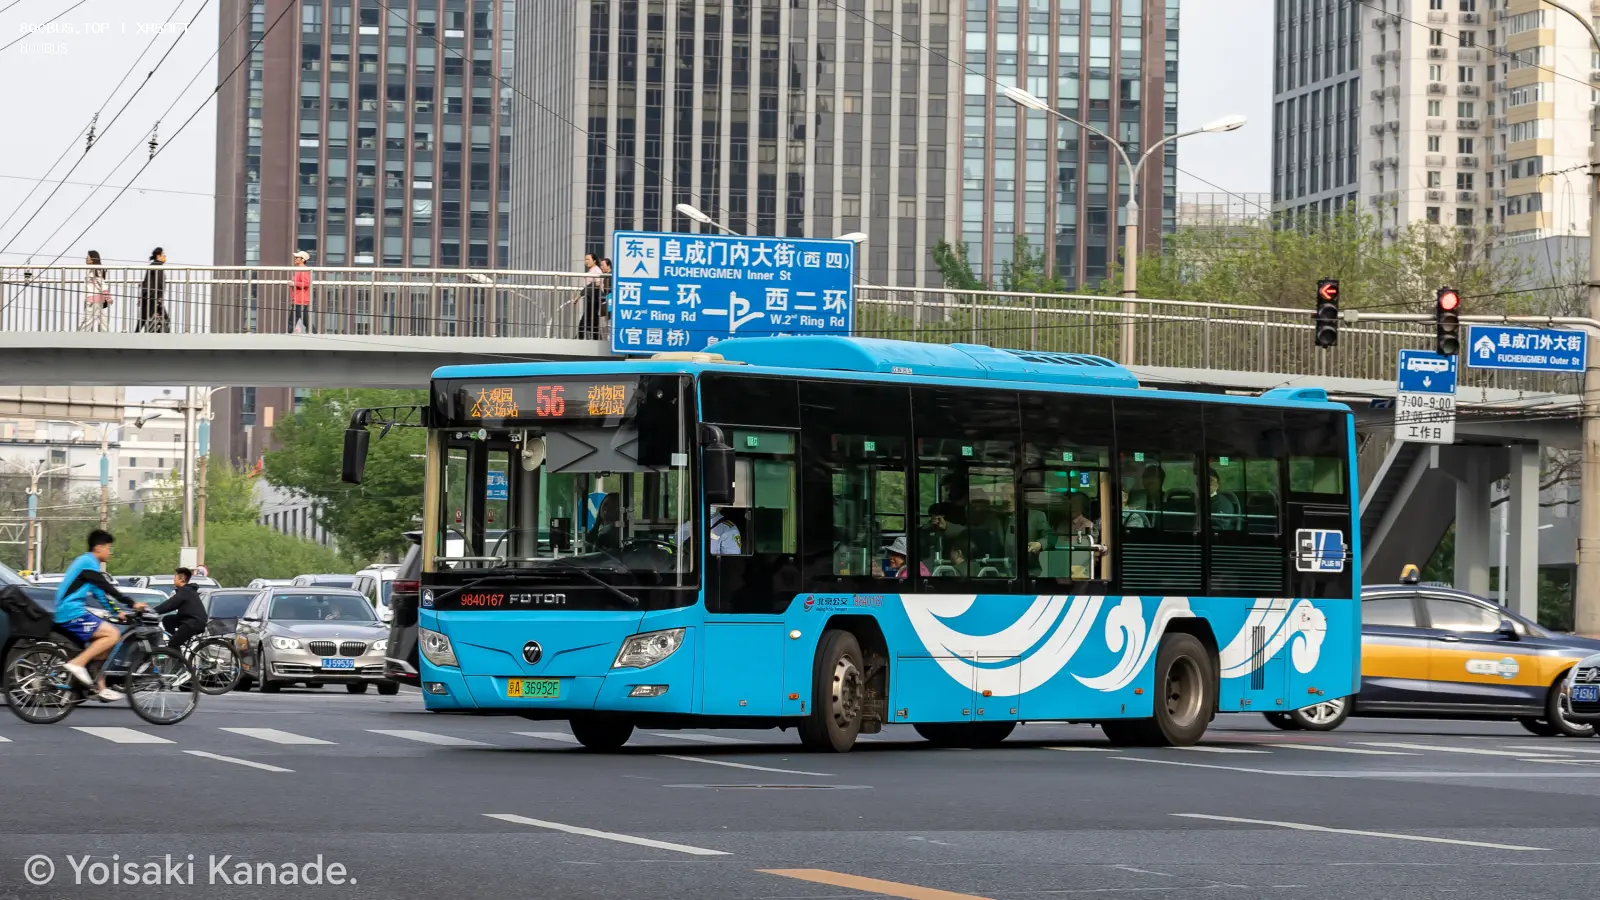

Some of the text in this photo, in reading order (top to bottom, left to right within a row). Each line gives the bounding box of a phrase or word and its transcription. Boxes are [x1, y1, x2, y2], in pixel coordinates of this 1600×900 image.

[625, 239, 655, 258] 东 E
[664, 266, 792, 281] FUCHENGMEN Inner St
[618, 282, 702, 308] 西二环
[765, 288, 848, 314] 西二环
[650, 310, 676, 324] Ring
[681, 311, 697, 322] Rd
[800, 315, 825, 329] Ring
[829, 316, 845, 327] Rd
[1497, 333, 1582, 351] 阜成门外大街
[1497, 354, 1580, 366] FUCHENGMEN Outer St
[477, 388, 513, 403] 大观园
[588, 385, 625, 401] 动物园
[536, 385, 565, 417] 56
[588, 400, 625, 416] 枢纽站
[471, 402, 519, 417] 公交场站
[1408, 426, 1442, 439] 工作日
[460, 593, 566, 606] 9840167 FOTON
[816, 597, 848, 606] 北京公交
